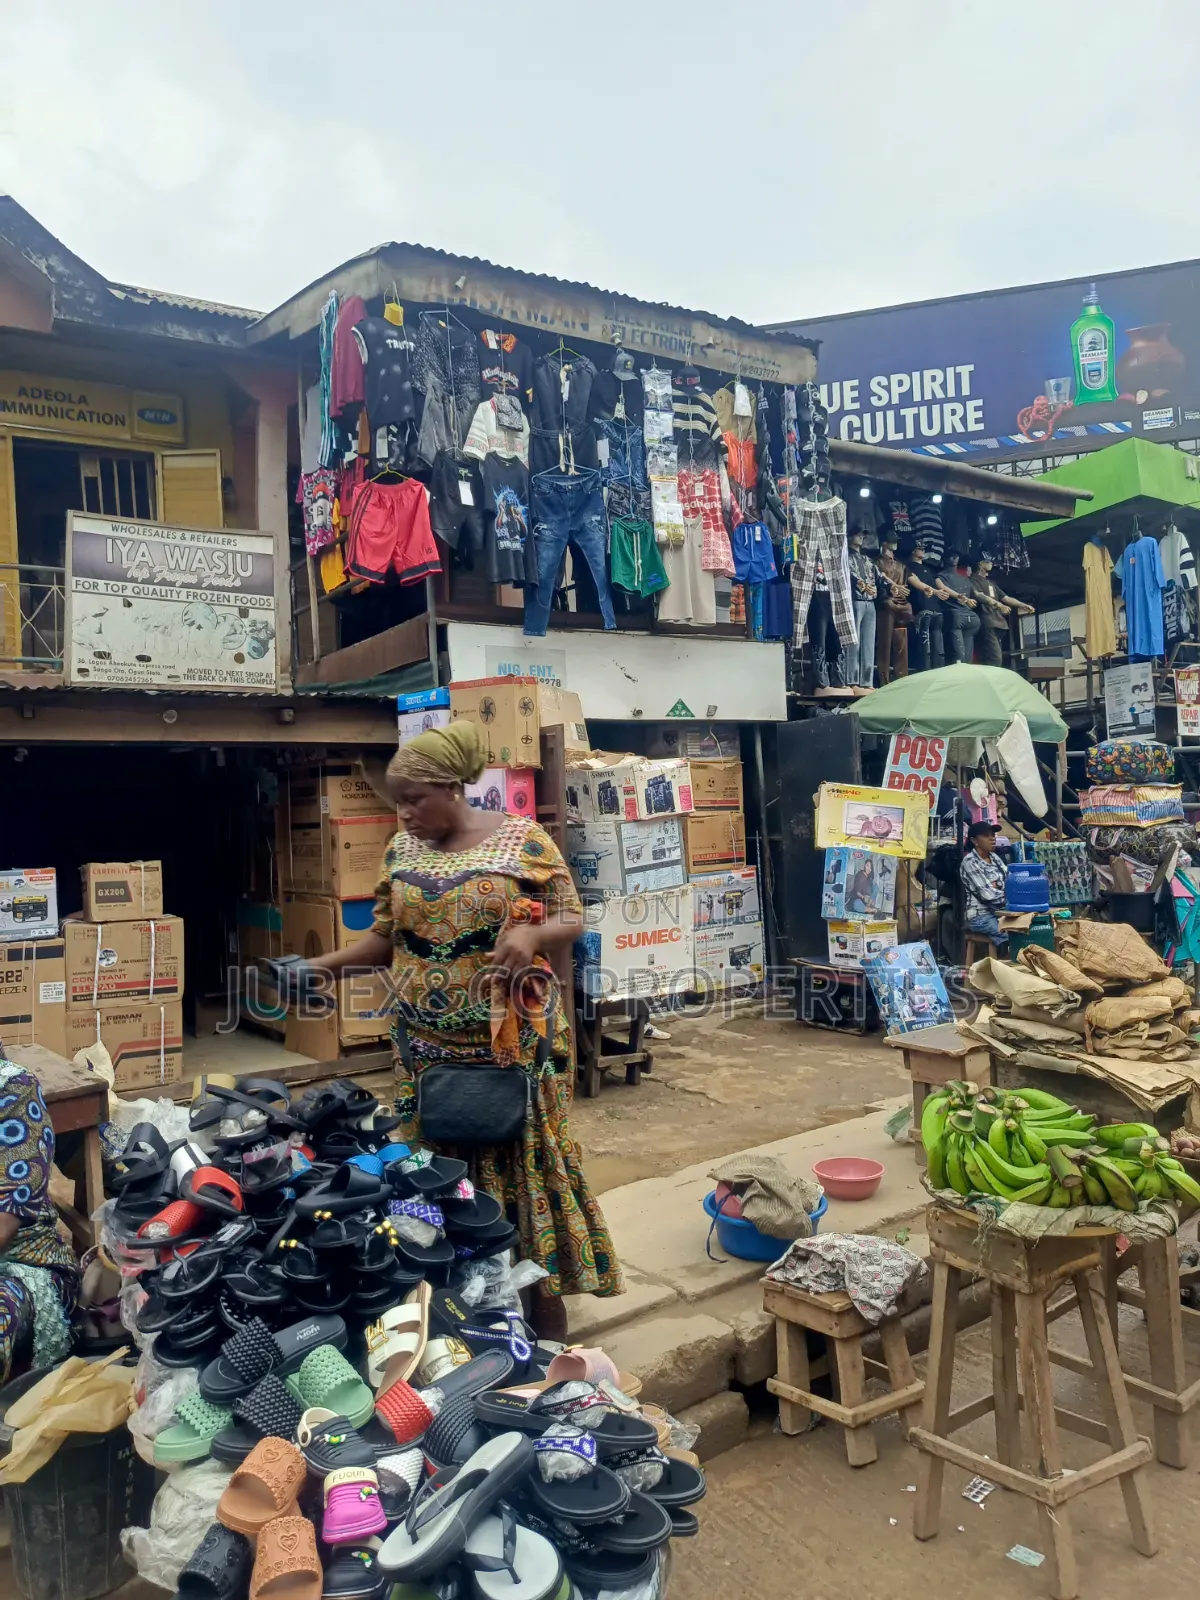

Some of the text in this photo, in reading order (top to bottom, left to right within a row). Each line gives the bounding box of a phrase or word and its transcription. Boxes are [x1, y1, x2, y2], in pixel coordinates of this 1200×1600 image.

[18, 386, 89, 406] ADEOLA
[870, 364, 976, 408] SPIRIT
[0, 399, 126, 427] MMUNICATION
[144, 411, 171, 422] MTN
[840, 399, 985, 443] CULTURE
[111, 523, 238, 547] WHOLESALES & RETAILERS
[105, 536, 253, 578] IYA WASIU
[122, 561, 150, 583] Top
[201, 570, 242, 588] Foods
[75, 579, 272, 607] FOR TOP QUALITY FROZEN FOODS
[1164, 585, 1177, 640] DIESEL
[199, 674, 216, 682] BACK
[497, 663, 556, 678] NIG. ENT.
[891, 733, 945, 772] POS
[887, 770, 938, 810] POS
[98, 888, 125, 897] GX200
[615, 927, 682, 950] SUMEC
[72, 973, 128, 983] CONTANT
[106, 1013, 142, 1021] FIRMAN
